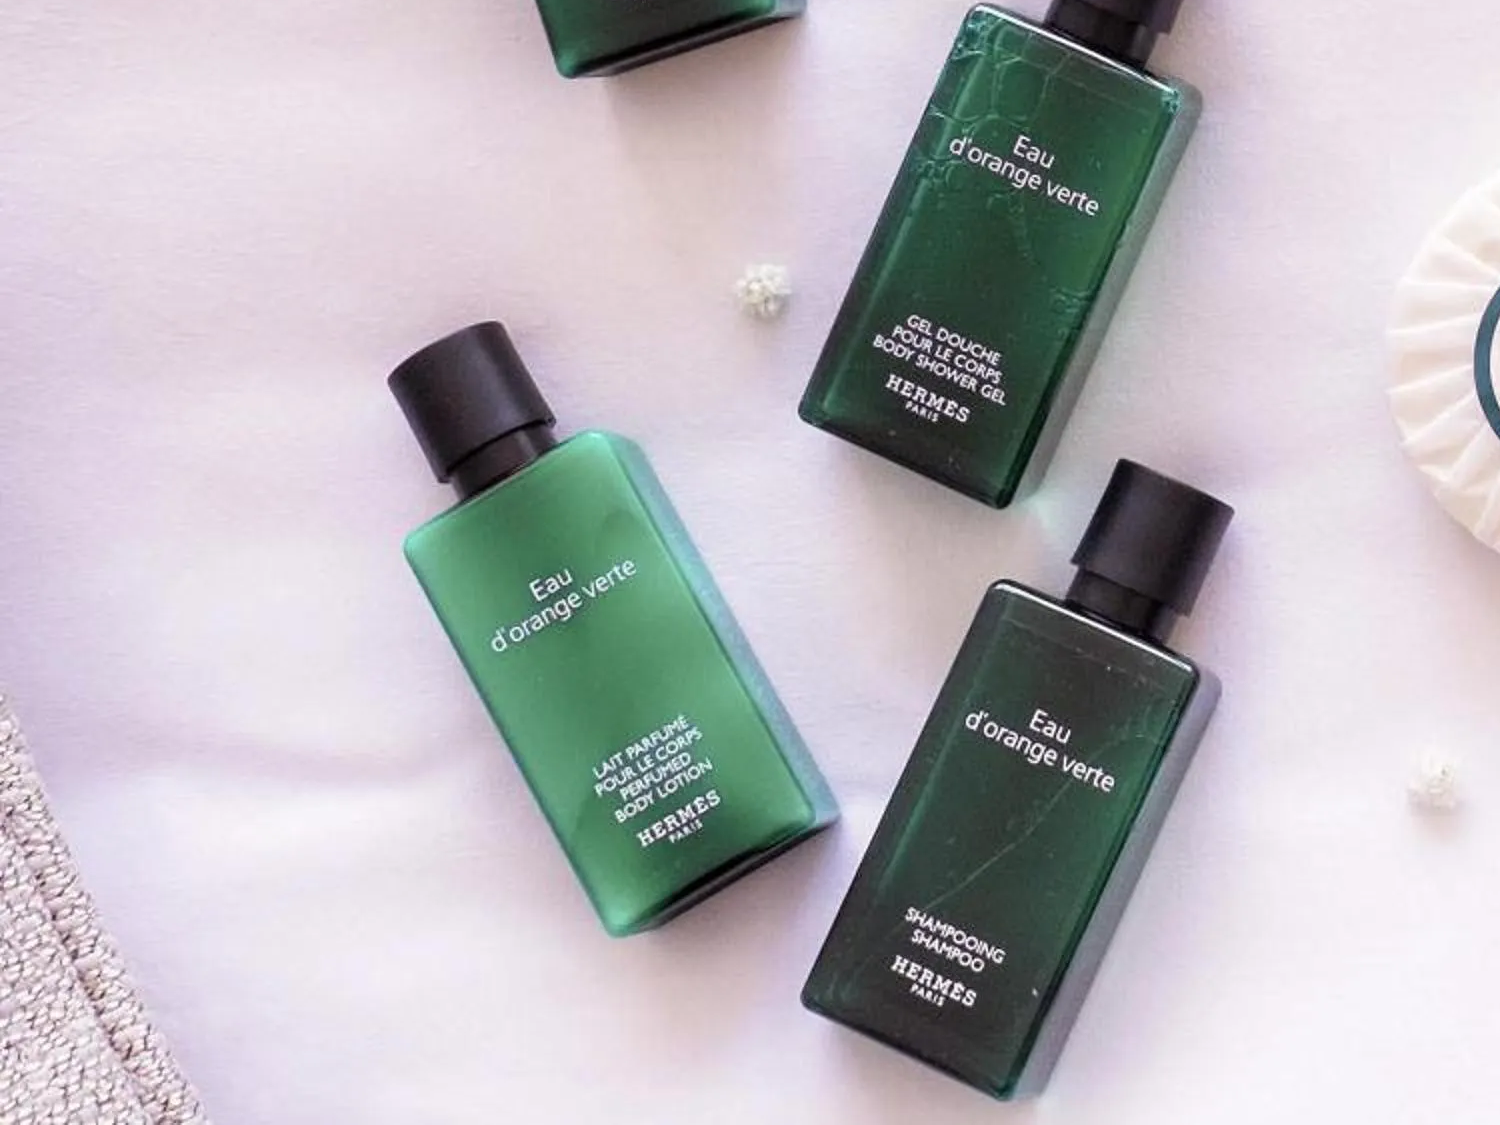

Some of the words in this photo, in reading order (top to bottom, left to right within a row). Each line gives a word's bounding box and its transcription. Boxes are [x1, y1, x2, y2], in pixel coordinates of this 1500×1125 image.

[950, 136, 1042, 189] d'orange
[1047, 180, 1100, 216] verte
[1013, 135, 1055, 168] Eau
[892, 325, 933, 353] POUR
[935, 345, 953, 362] LE
[954, 355, 1002, 385] CORPS
[907, 314, 932, 336] GEL
[936, 328, 1002, 366] DOUCHE
[873, 334, 915, 361] BODY
[915, 353, 978, 393] SHOWER
[981, 384, 1006, 406] GEL
[905, 401, 939, 422] PARIS
[491, 592, 583, 652] d'orange
[581, 559, 637, 599] verte
[529, 568, 573, 601] Eau
[1029, 708, 1072, 744] Eau
[592, 752, 624, 779] LAIT
[594, 766, 637, 798] POUR
[636, 754, 655, 773] LE
[656, 726, 703, 761] CORPS
[619, 752, 692, 801] PERFUMED
[965, 710, 1058, 766] d'orange
[1062, 755, 1115, 793] verte
[614, 791, 655, 823] BODY
[657, 757, 713, 799] LOTION
[669, 819, 703, 843] PARIS
[905, 907, 1006, 964] SHAMPOOING
[912, 929, 985, 972] SHAMPOO
[910, 983, 946, 1007] PARIS
